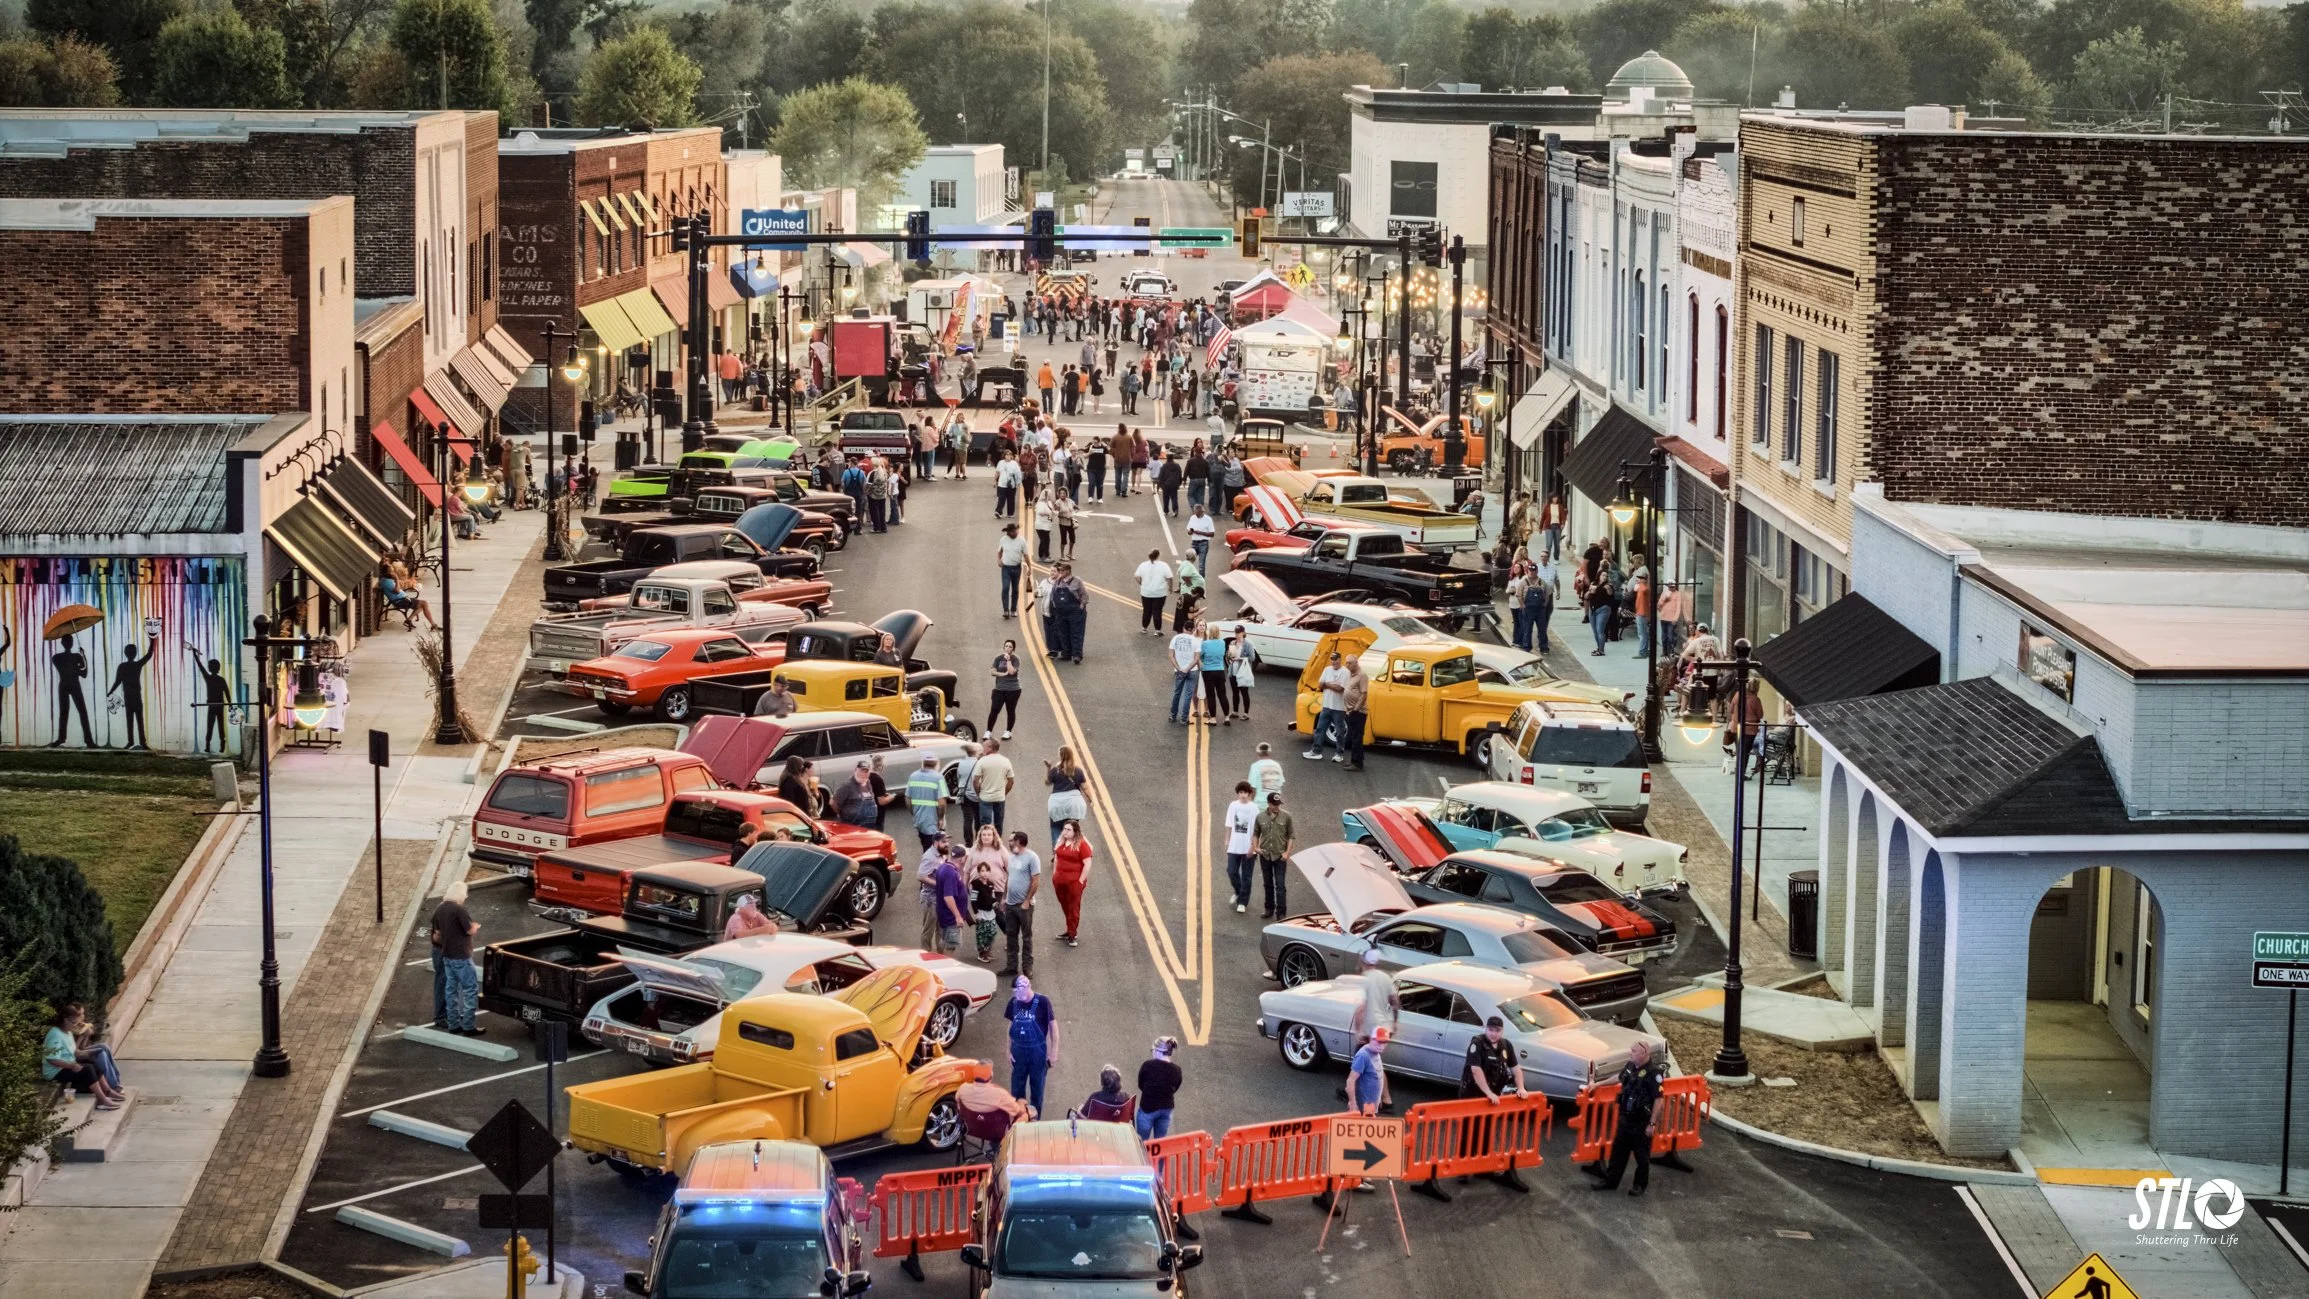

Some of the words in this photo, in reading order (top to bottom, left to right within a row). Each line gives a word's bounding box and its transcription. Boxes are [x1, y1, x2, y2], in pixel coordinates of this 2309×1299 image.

[764, 218, 804, 229] United
[500, 281, 552, 291] EDICINES
[500, 295, 518, 305] ALL
[521, 295, 562, 306] PAPER
[48, 558, 223, 584] PLEASANT
[485, 828, 557, 846] DODGE
[2258, 938, 2309, 954] CHURCH
[2262, 969, 2284, 979] ONE
[1269, 1121, 1312, 1138] MPPD
[1336, 1123, 1397, 1138] DETOUR
